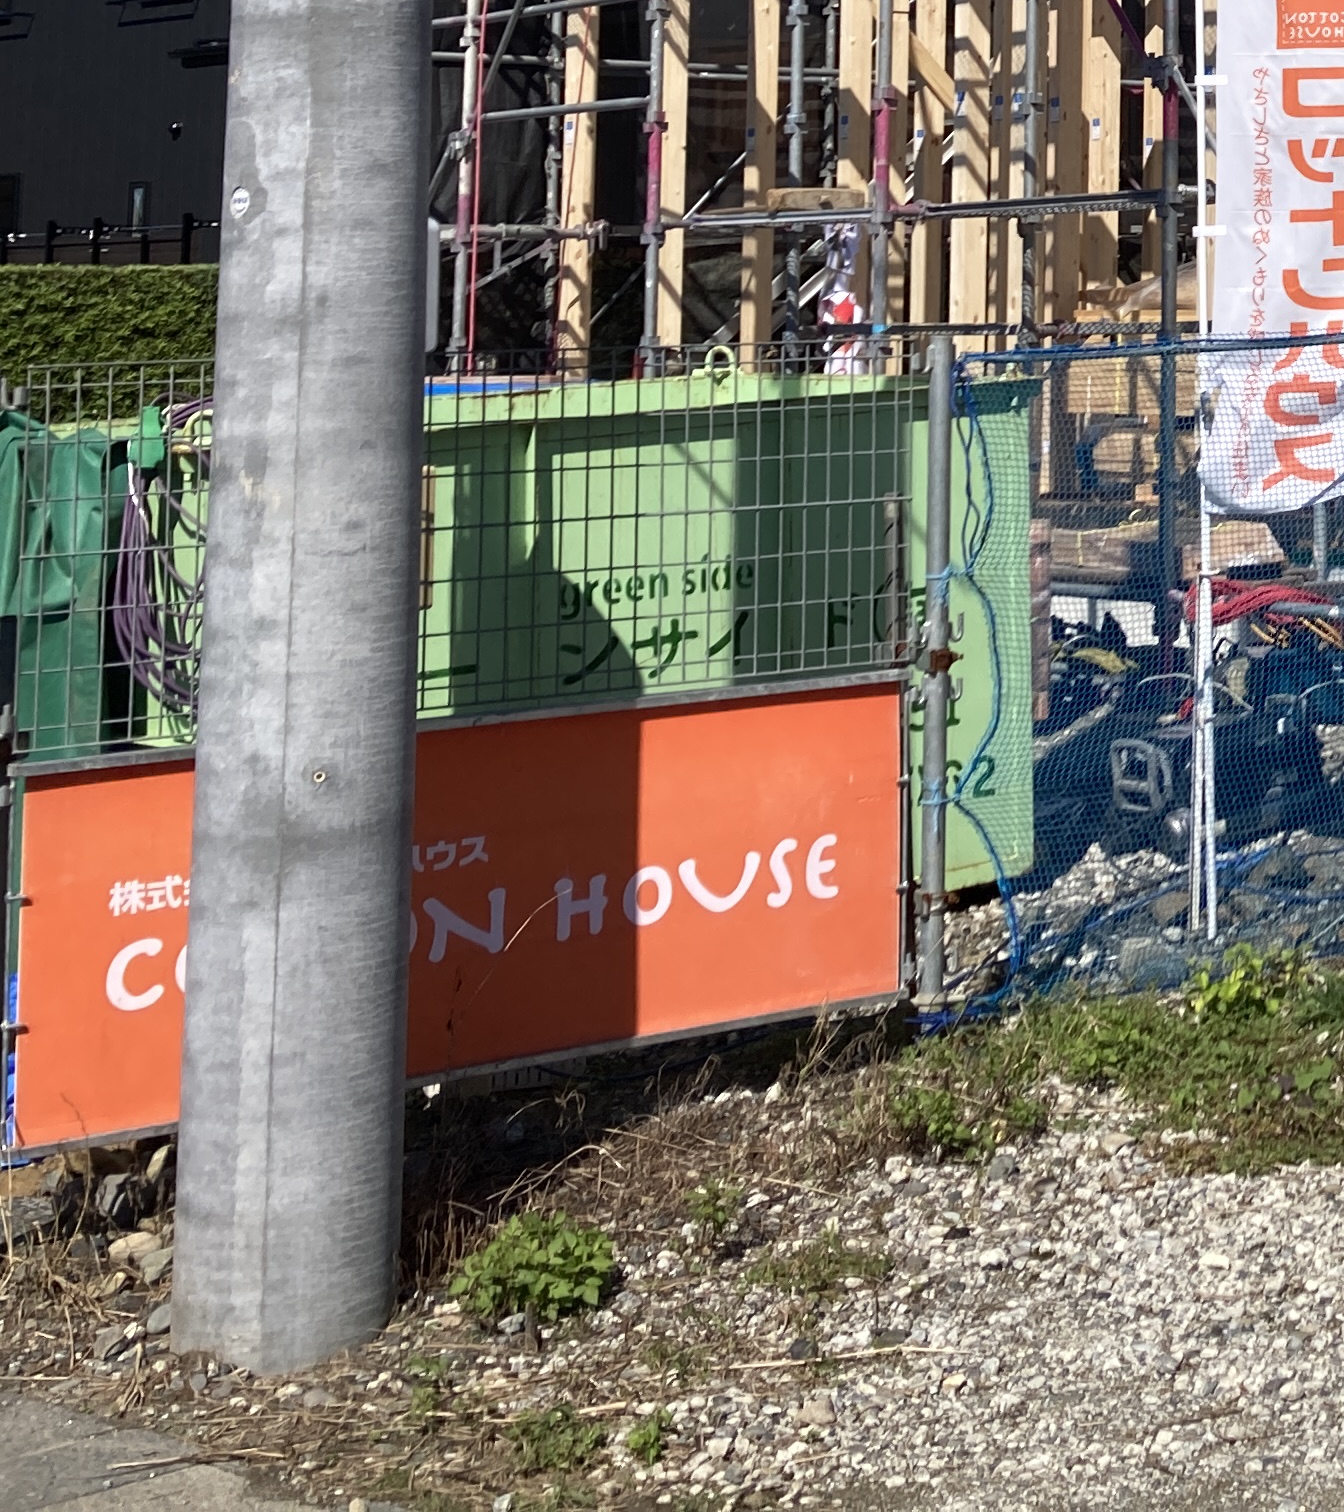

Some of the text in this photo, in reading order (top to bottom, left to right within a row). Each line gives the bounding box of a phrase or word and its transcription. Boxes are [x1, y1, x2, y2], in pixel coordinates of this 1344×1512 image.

[560, 552, 755, 620] green side
[552, 832, 840, 942] HOUSE
